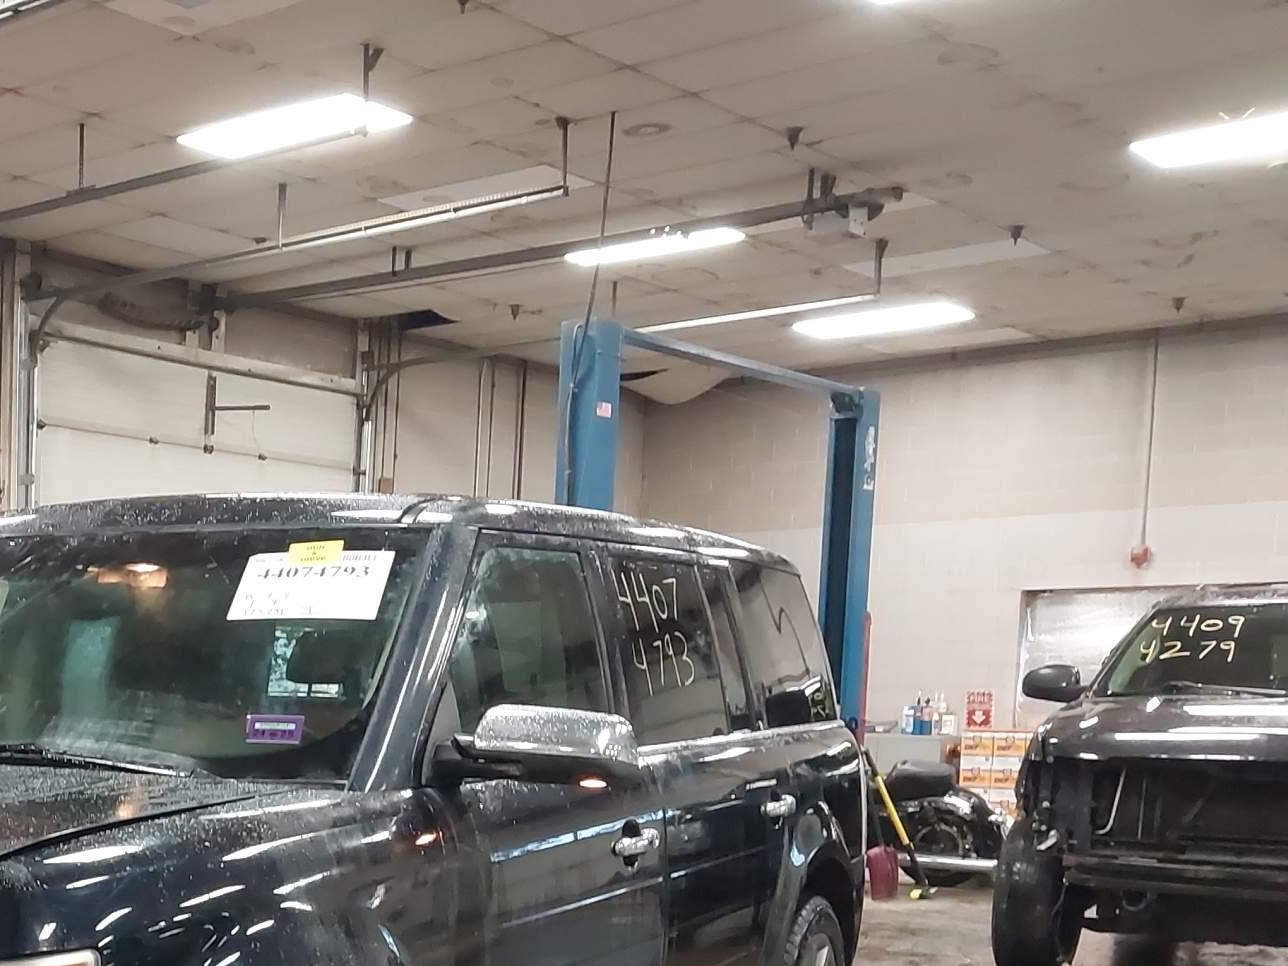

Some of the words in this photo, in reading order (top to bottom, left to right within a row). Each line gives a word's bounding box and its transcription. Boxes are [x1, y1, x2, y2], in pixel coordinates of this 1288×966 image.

[257, 565, 369, 580] 44074793
[611, 569, 678, 633] 4407
[1152, 614, 1245, 638] 4409
[1140, 640, 1235, 663] 4279
[632, 631, 695, 697] 4793
